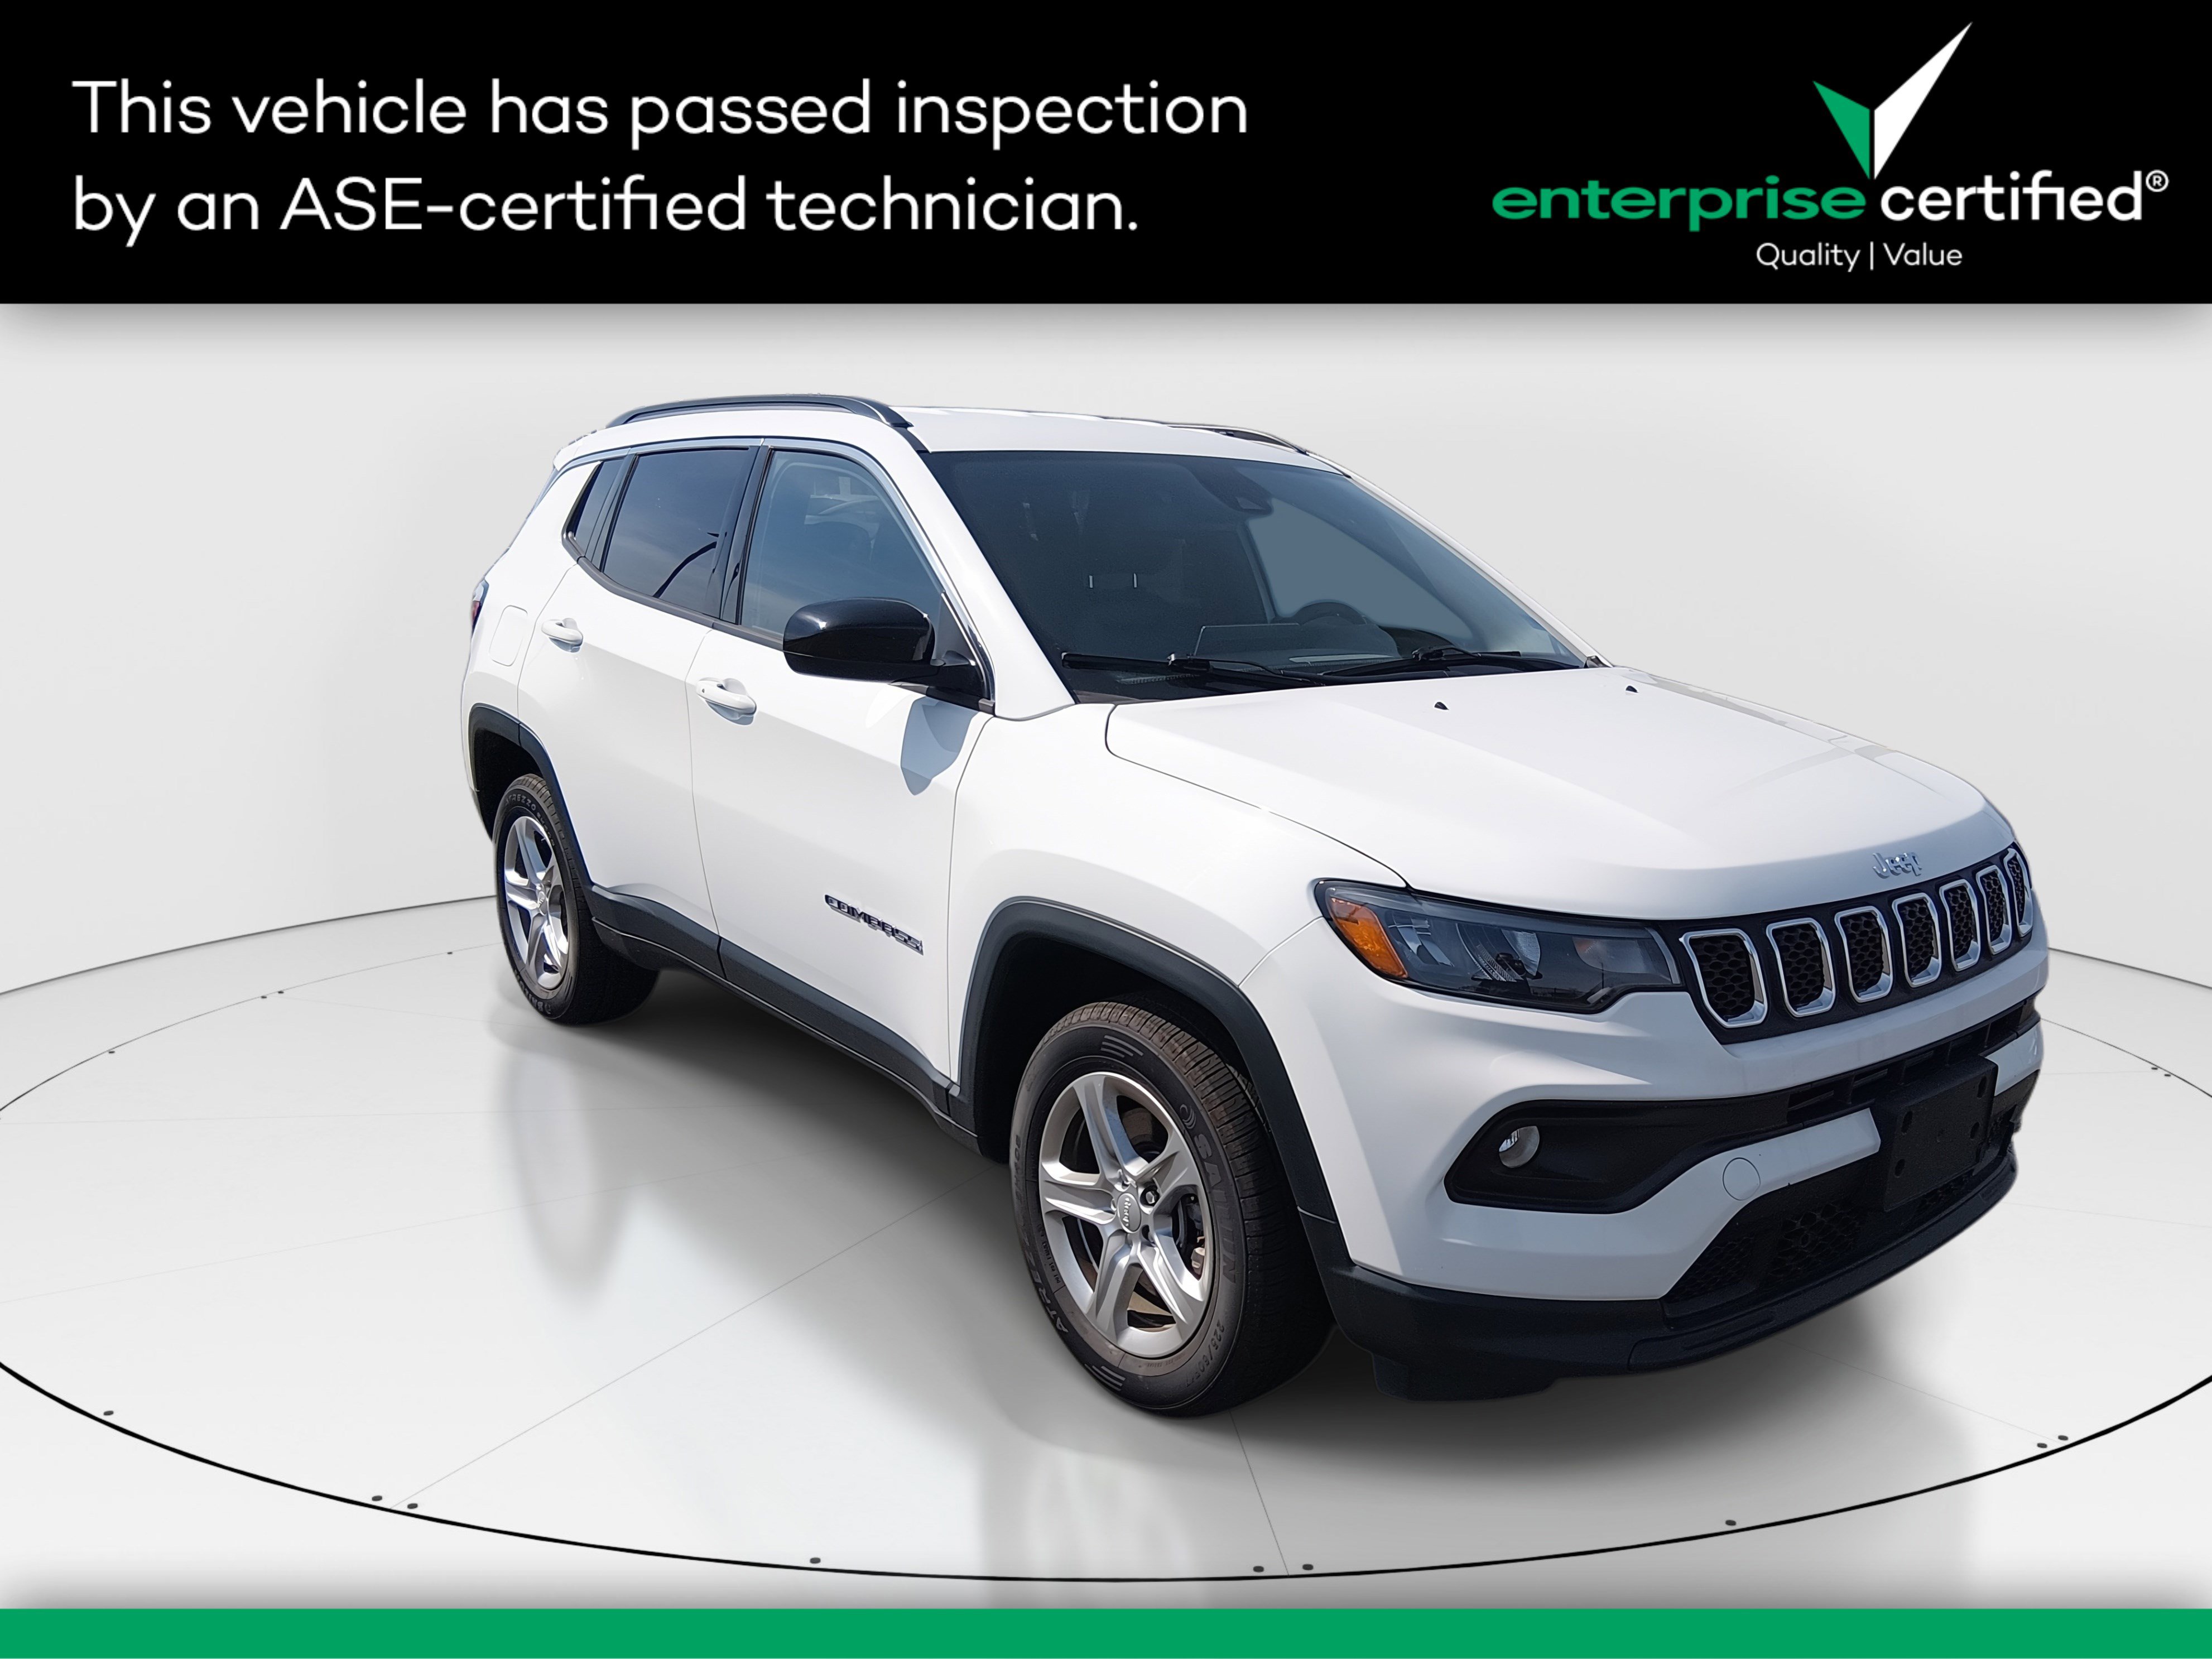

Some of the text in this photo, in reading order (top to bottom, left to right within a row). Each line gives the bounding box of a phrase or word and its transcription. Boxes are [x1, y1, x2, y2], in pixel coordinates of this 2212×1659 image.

[1872, 852, 1922, 879] Jeep
[824, 893, 924, 955] COMPASS
[1018, 1219, 1069, 1333] ATREZZ
